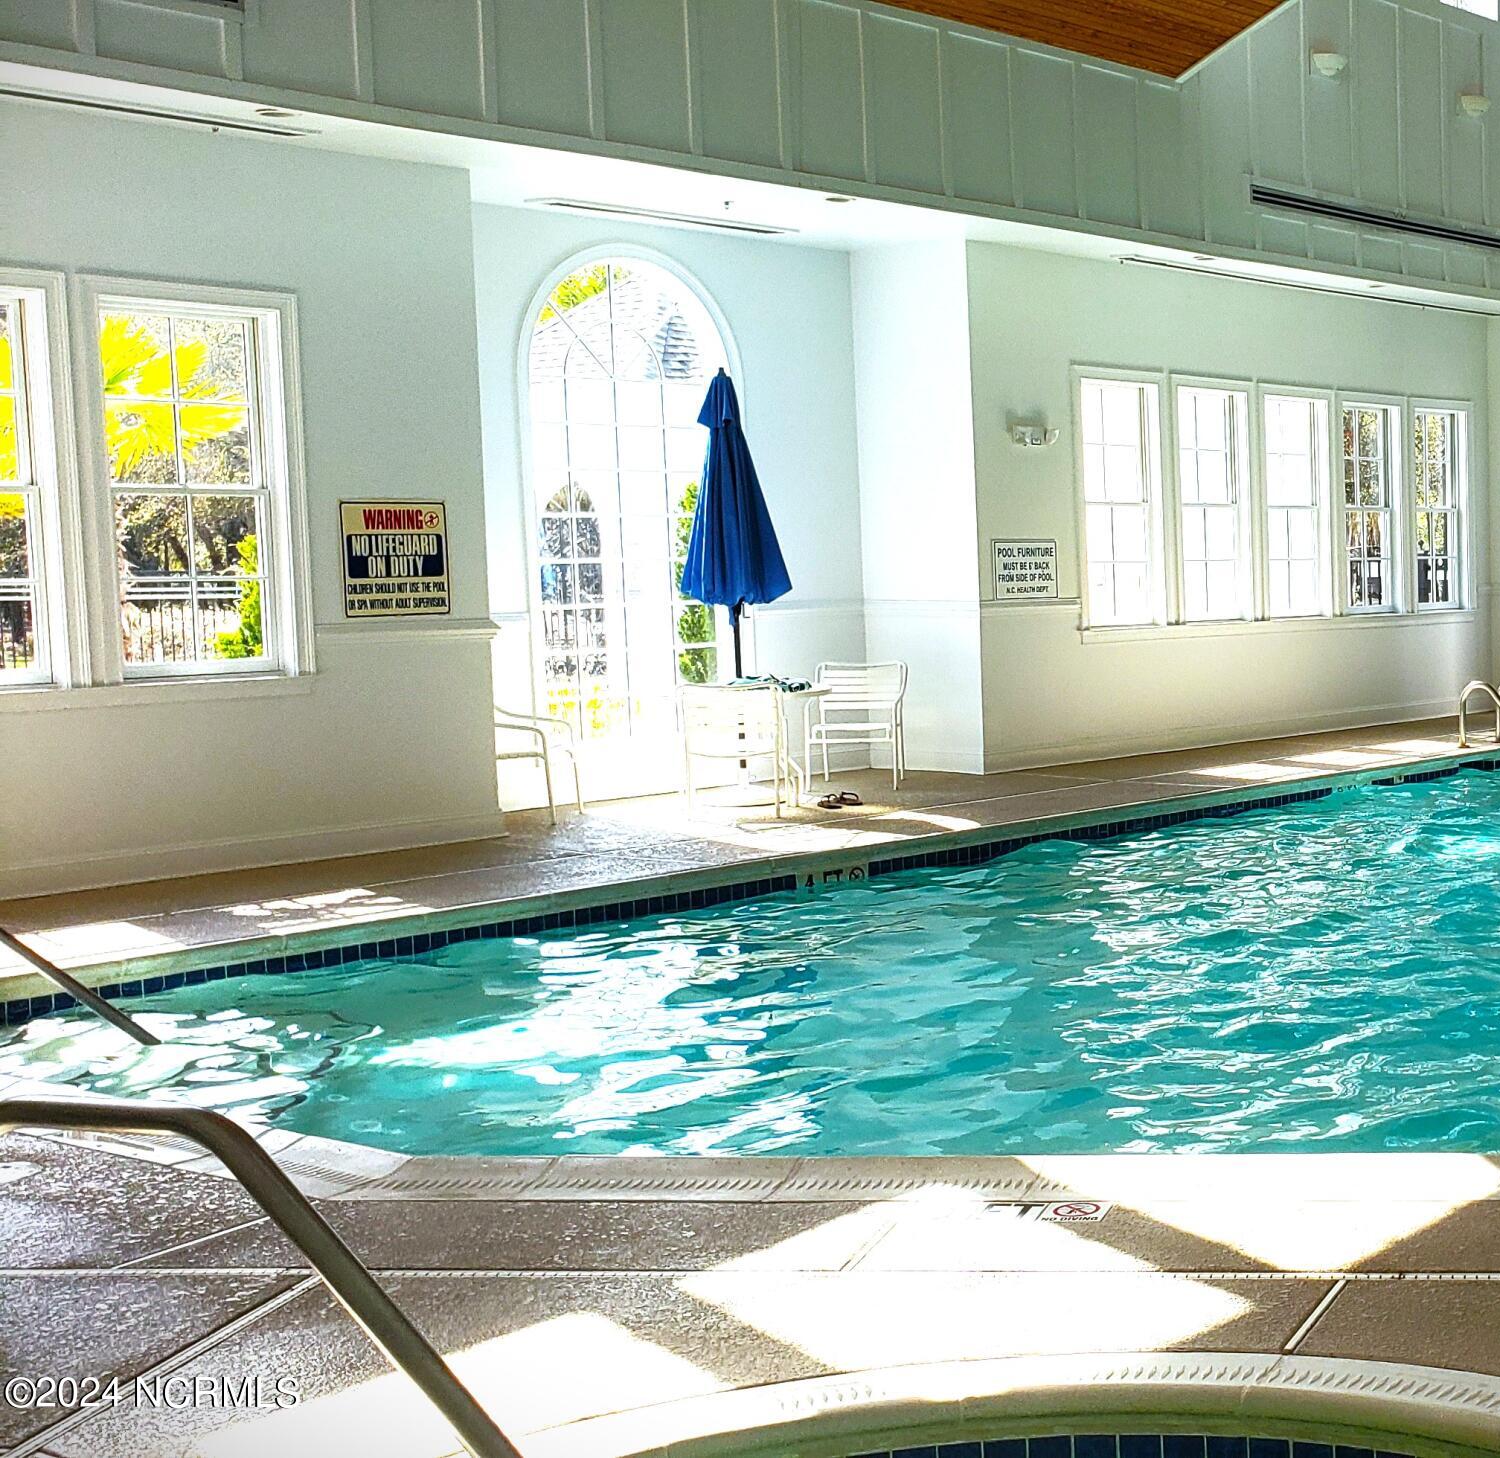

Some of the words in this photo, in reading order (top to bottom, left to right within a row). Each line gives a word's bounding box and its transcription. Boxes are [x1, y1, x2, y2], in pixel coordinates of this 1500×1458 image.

[363, 509, 424, 530] WARNING
[351, 535, 369, 556] NO
[371, 535, 438, 556] LIFEGUARD
[997, 547, 1016, 558] POOL
[1017, 547, 1054, 558] FURNITURE
[367, 557, 387, 578] ON
[390, 556, 424, 577] DUTY
[1003, 562, 1018, 571] MUST
[1019, 562, 1028, 571] BE
[1034, 561, 1050, 571] BACK
[998, 573, 1014, 583] FROM
[1015, 573, 1028, 582] SIDE
[1029, 573, 1037, 582] OF
[347, 583, 374, 595] CHILDREN
[374, 582, 396, 594] SHOULD
[397, 582, 408, 593] NOT
[409, 581, 420, 593] USE
[421, 581, 432, 593] THE
[433, 581, 447, 593] POOL
[348, 599, 356, 611] OR
[357, 598, 369, 611] SPA
[369, 598, 394, 610] WITHOUT
[395, 597, 411, 609] ADULT
